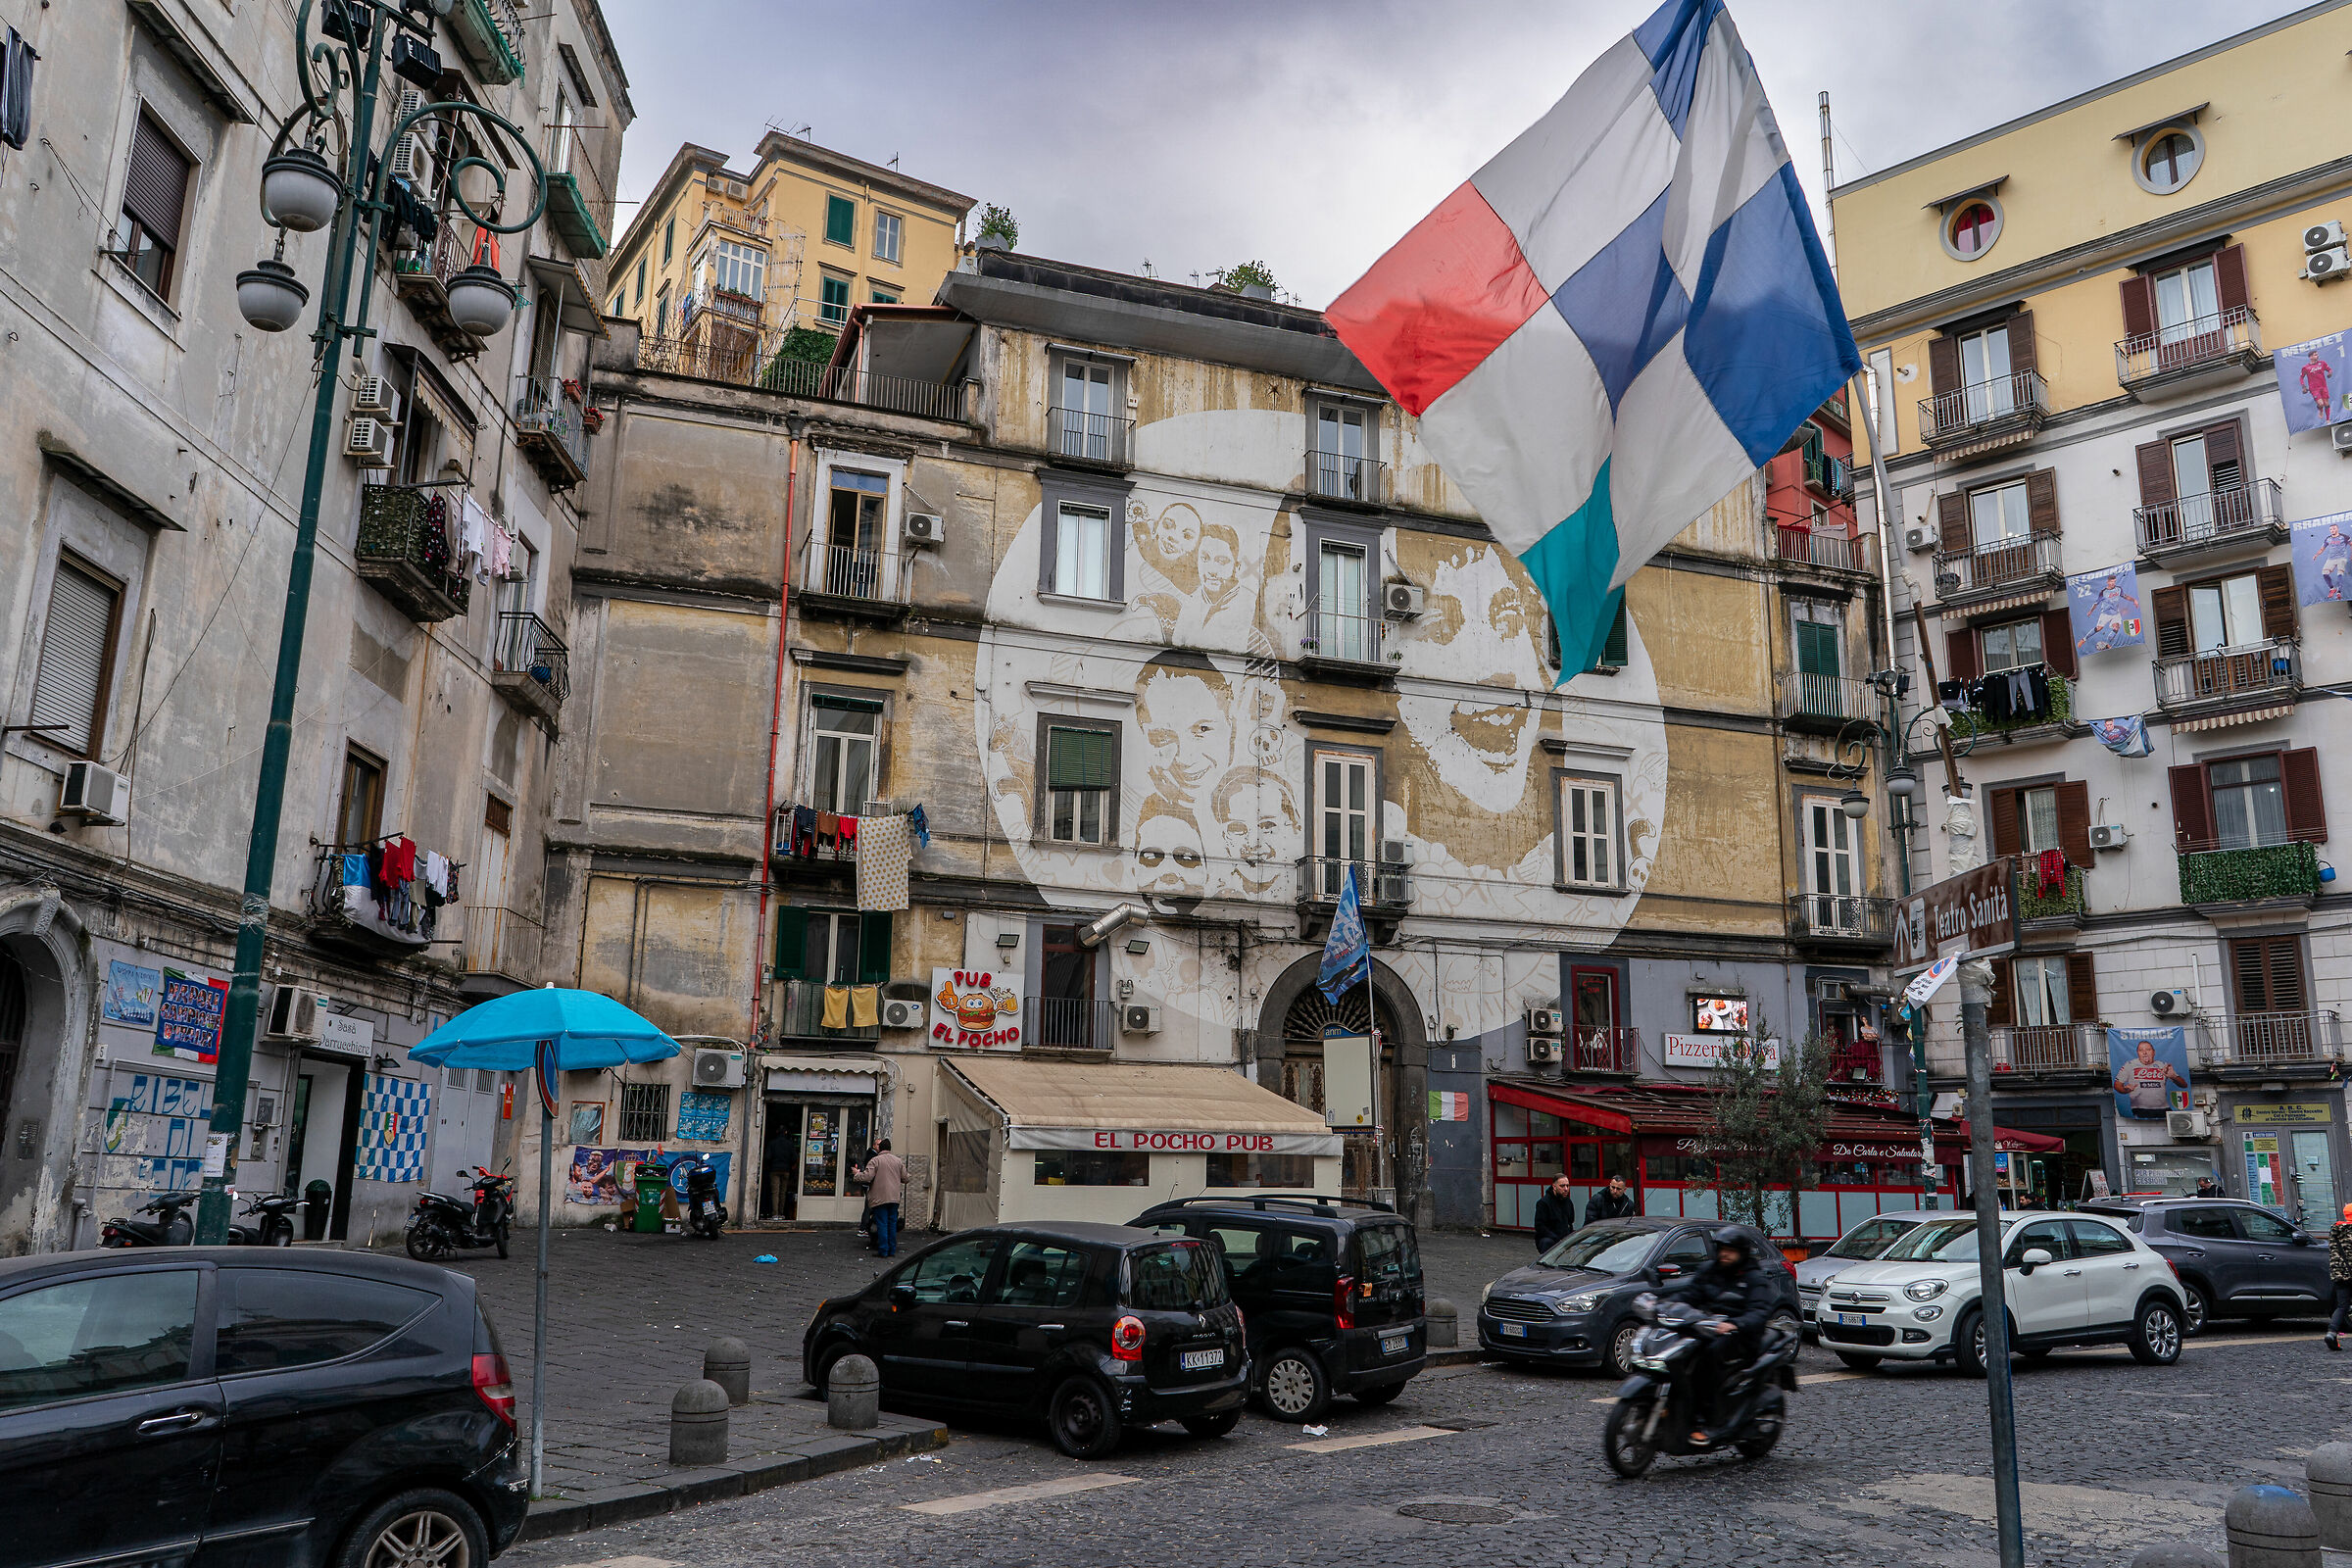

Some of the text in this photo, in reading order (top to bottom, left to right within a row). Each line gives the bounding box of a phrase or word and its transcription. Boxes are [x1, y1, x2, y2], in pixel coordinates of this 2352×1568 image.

[2337, 345, 2345, 358] 1
[2078, 585, 2092, 598] 22
[1934, 885, 2009, 939] Teatro Sanità
[954, 970, 992, 988] PUB
[168, 981, 220, 1011] NAPOLI
[337, 1019, 357, 1035] Sasà
[933, 1022, 1019, 1048] EL POCHO
[1325, 1027, 1342, 1036] anm
[2120, 1029, 2174, 1040] STARACE
[1668, 1036, 1731, 1058] Pizzeri
[1095, 1132, 1274, 1152] EL POCHO PUB
[1886, 1145, 1922, 1157] Salvator
[1200, 1349, 1222, 1364] 11372
